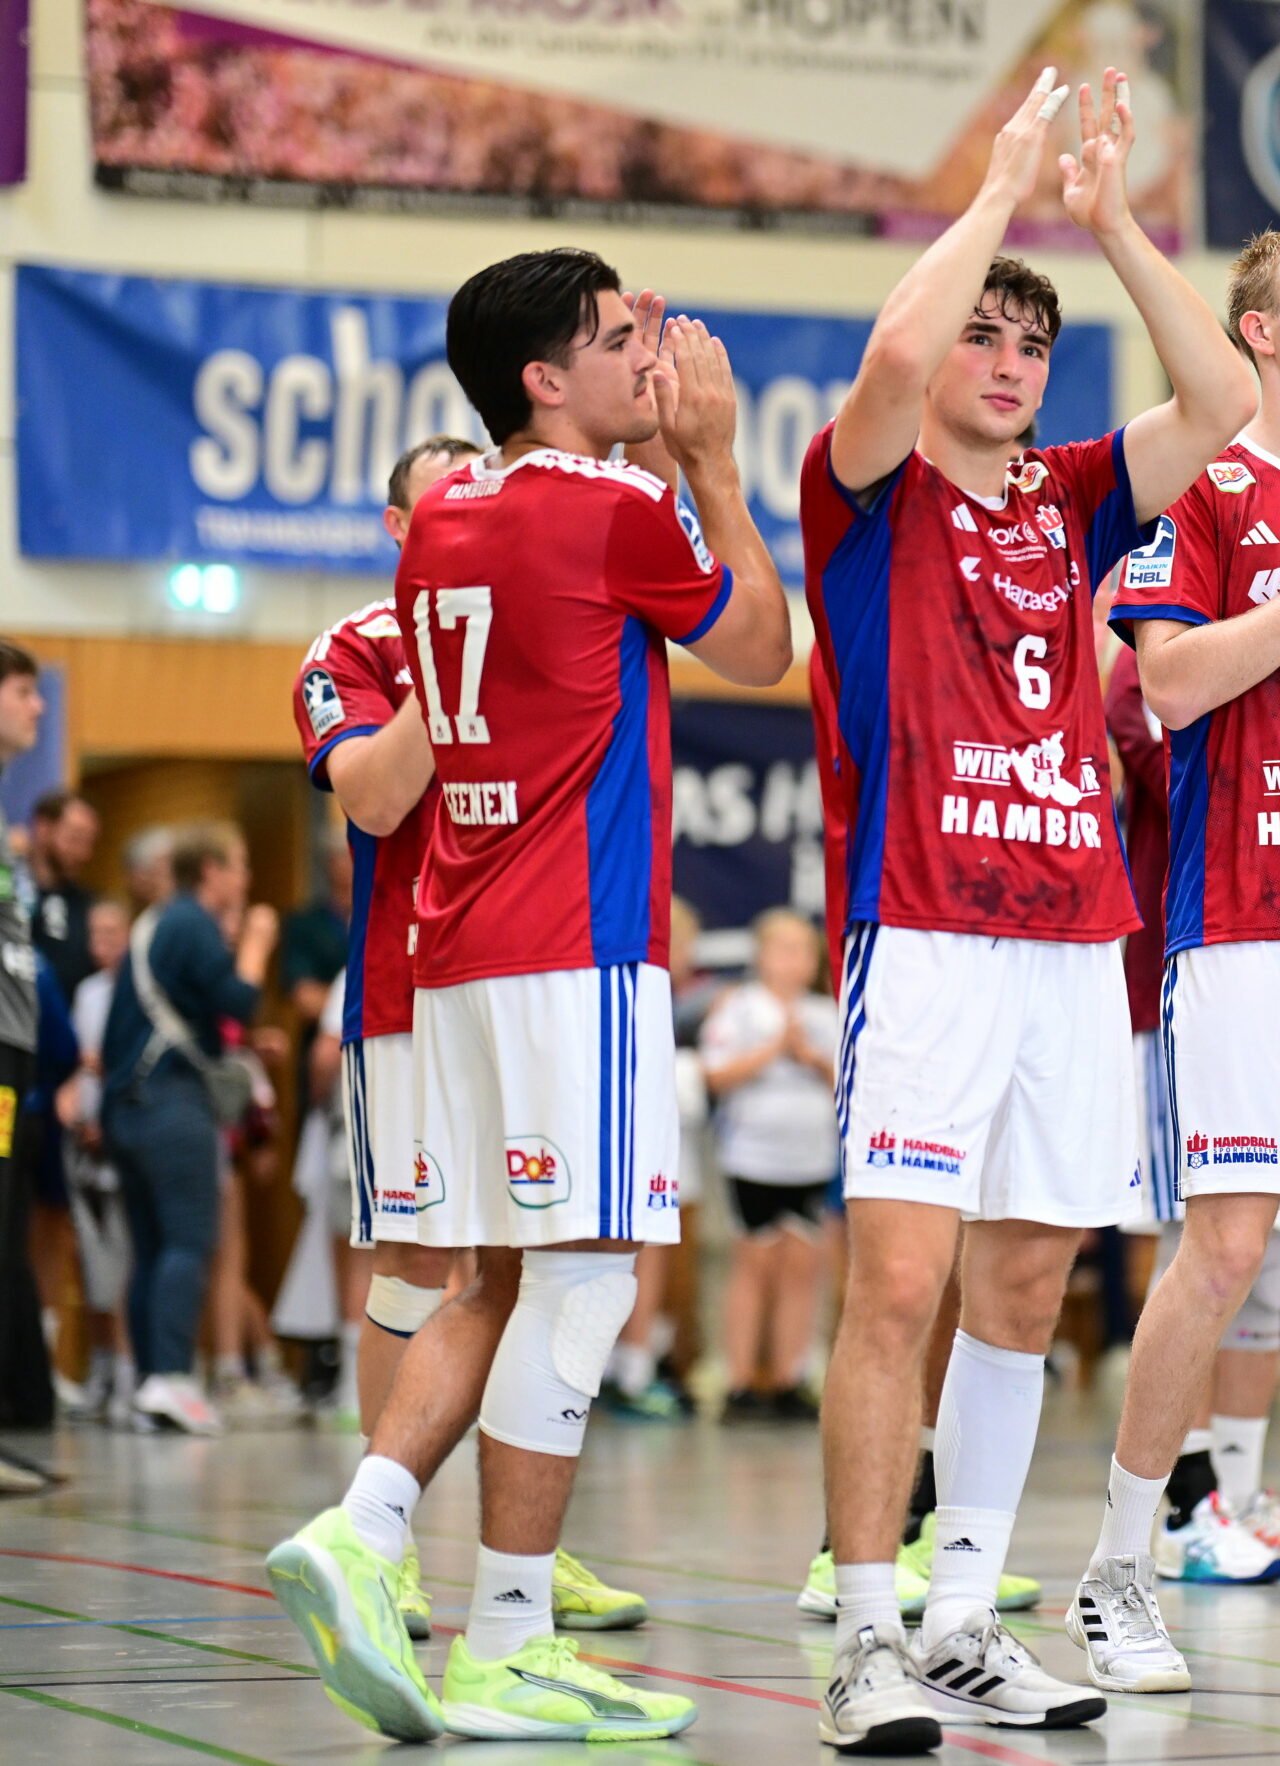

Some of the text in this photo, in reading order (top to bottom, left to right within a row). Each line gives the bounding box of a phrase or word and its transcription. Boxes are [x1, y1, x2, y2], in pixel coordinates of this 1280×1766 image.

[1130, 571, 1167, 583] HBL
[412, 586, 494, 744] 17
[1013, 634, 1051, 710] 6
[953, 747, 1011, 781] WIR
[1212, 1136, 1278, 1149] HANDBALL
[1212, 1153, 1279, 1164] HAMBURG
[506, 1148, 557, 1181] Dole
